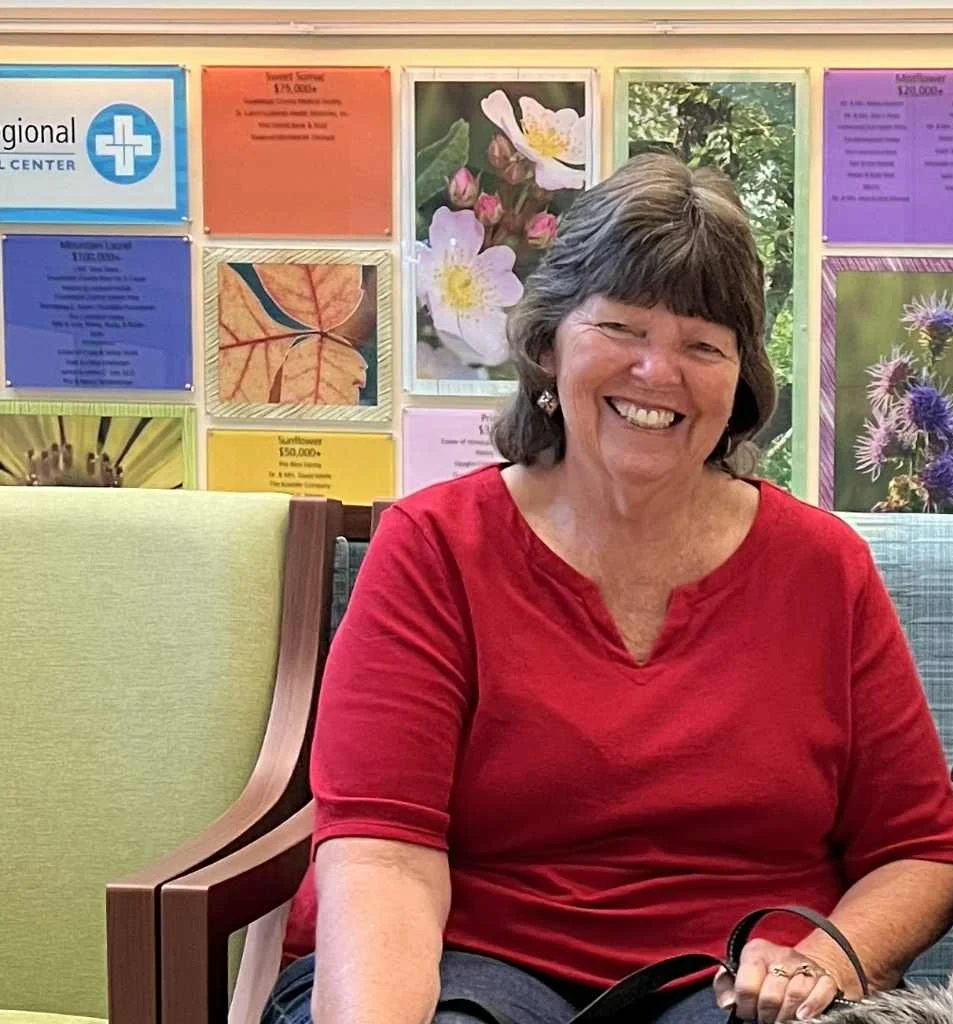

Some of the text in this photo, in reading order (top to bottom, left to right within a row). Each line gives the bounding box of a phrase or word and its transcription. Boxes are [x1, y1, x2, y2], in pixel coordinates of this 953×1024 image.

[0, 116, 75, 150] gional
[10, 159, 76, 170] CENTER
[278, 436, 323, 446] Sunflower
[279, 446, 321, 457] $50,000+
